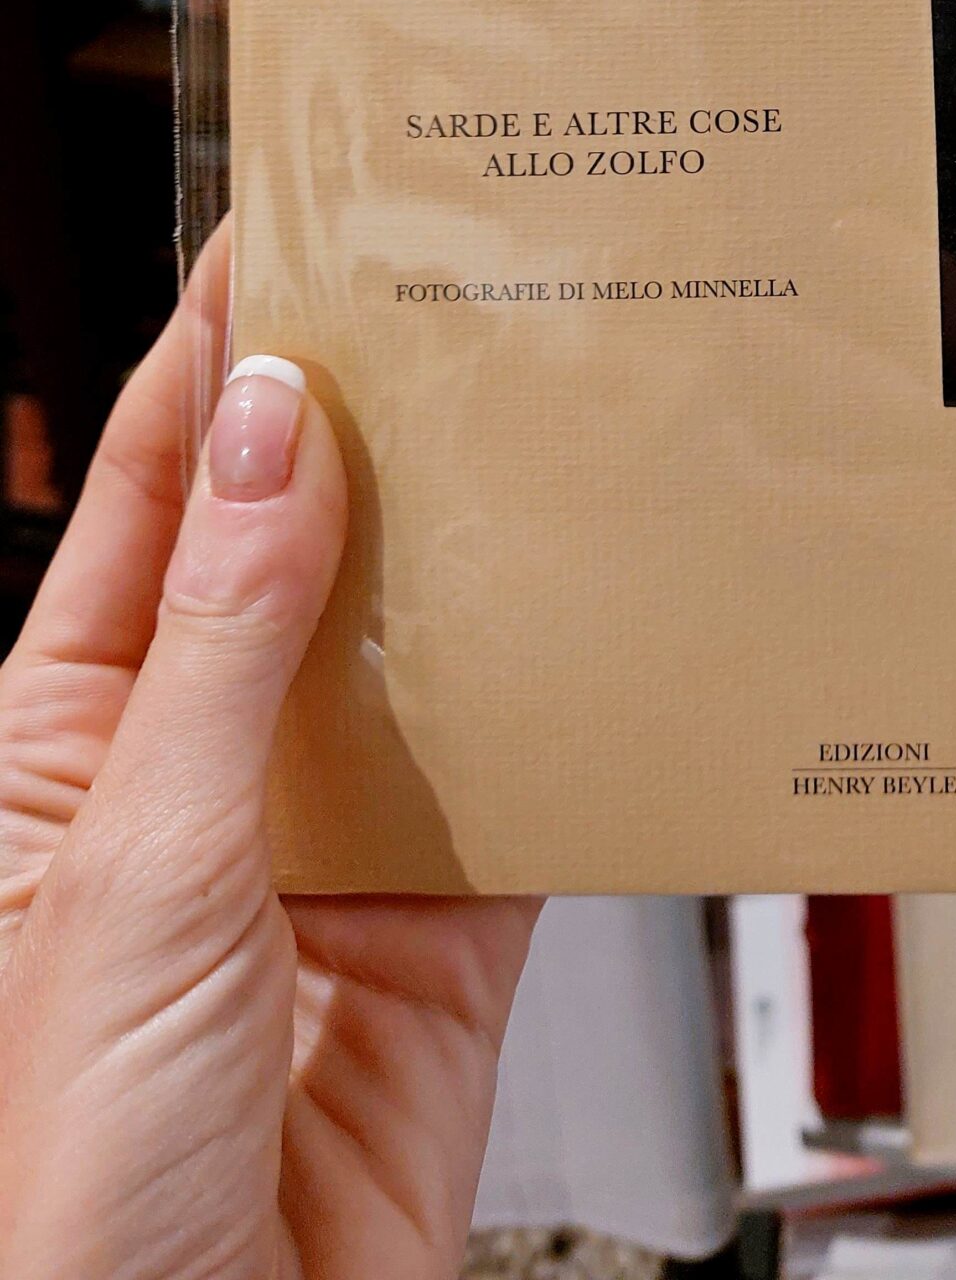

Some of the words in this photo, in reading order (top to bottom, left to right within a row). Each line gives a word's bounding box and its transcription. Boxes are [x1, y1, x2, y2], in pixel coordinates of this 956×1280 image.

[406, 113, 521, 139] SARDE
[532, 112, 553, 137] E
[562, 110, 678, 137] ALTRE
[689, 108, 782, 135] COSE
[481, 151, 575, 178] ALLO
[586, 149, 705, 176] ZOLFO
[395, 282, 551, 303] FOTOGRAFIE
[558, 282, 585, 301] DI
[591, 280, 663, 301] MELO
[670, 278, 800, 300] MINNELLA
[819, 742, 930, 763] EDIZIONI
[792, 776, 876, 796] HENRY
